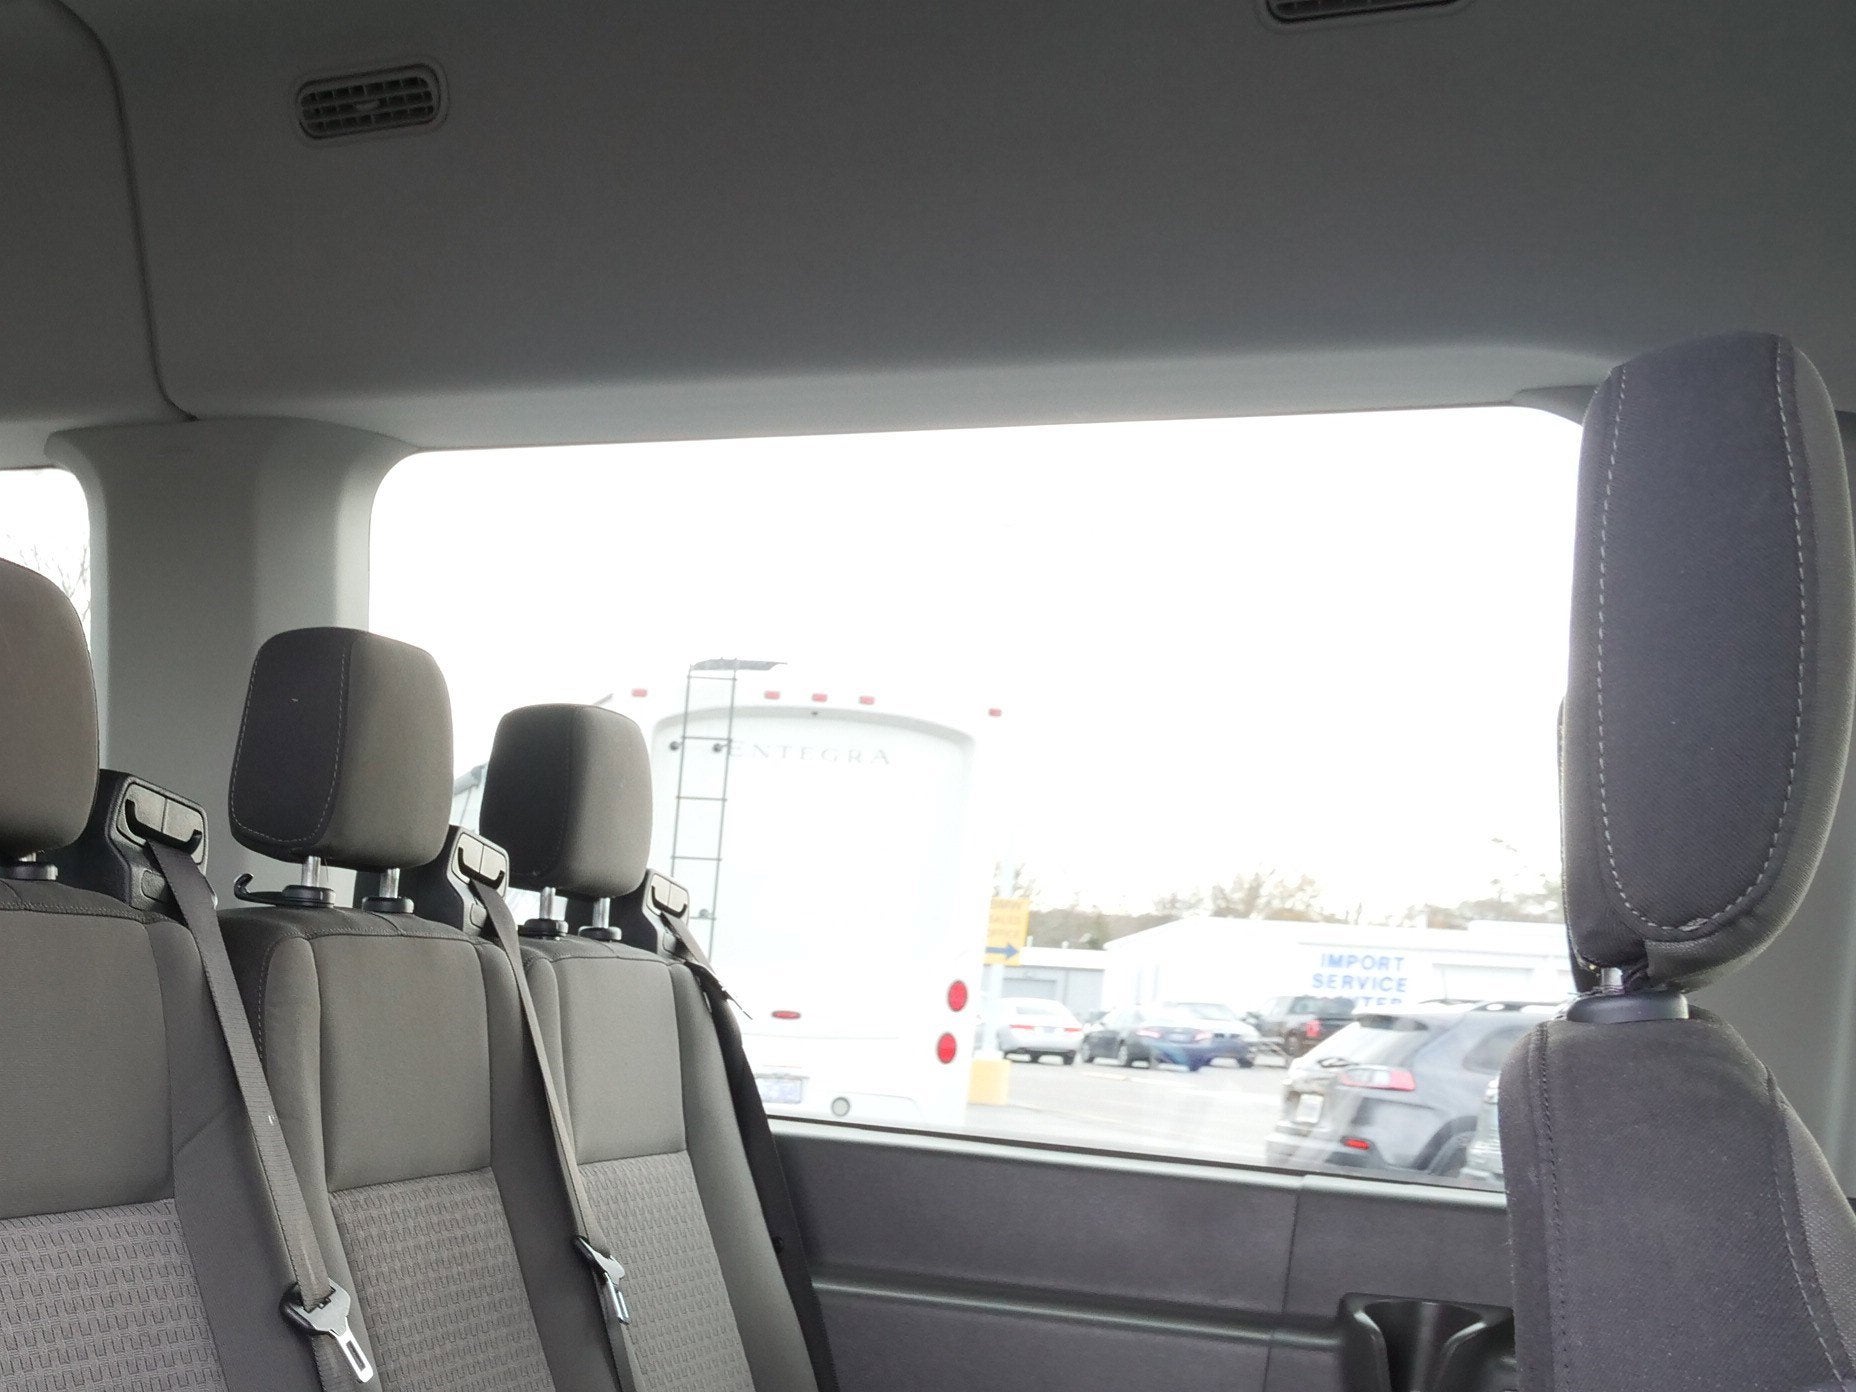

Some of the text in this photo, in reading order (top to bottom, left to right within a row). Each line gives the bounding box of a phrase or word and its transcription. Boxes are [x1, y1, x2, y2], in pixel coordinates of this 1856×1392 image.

[730, 739, 891, 766] ENTEGRA
[1321, 953, 1406, 972] IMPORT
[1311, 972, 1408, 993] SERVICE
